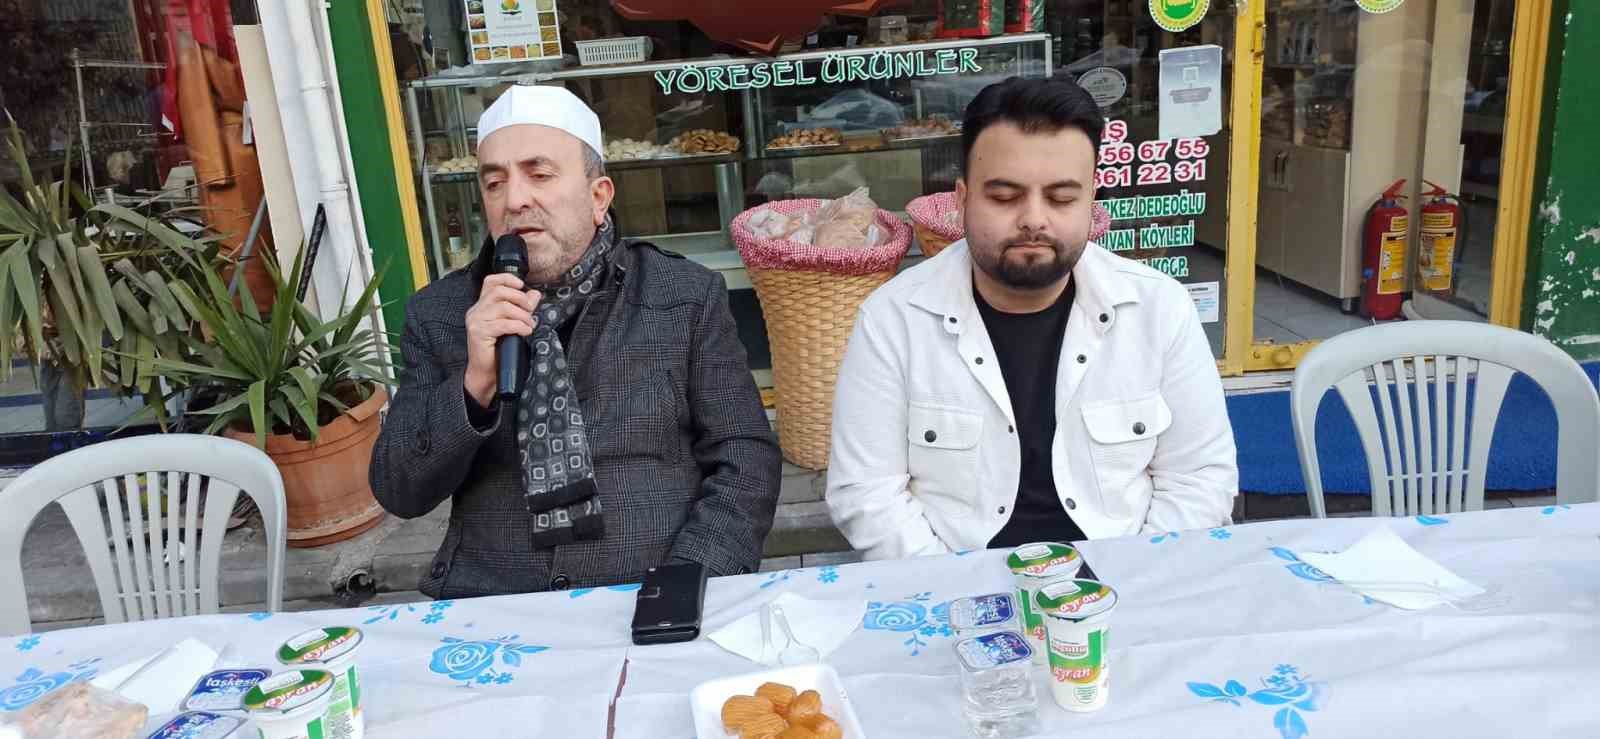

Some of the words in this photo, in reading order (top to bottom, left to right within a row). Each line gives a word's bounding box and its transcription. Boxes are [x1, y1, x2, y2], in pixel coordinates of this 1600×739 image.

[655, 61, 815, 95] YÖRESEL
[821, 48, 982, 84] ÜRÜNLER
[1138, 140, 1171, 161] 67
[1175, 137, 1209, 159] 55
[1137, 163, 1171, 185] 22
[1174, 160, 1206, 181] 31
[1137, 190, 1206, 218] DEDEOĞLU
[1140, 220, 1194, 249] KÖYLERİ
[1059, 592, 1100, 612] ayran
